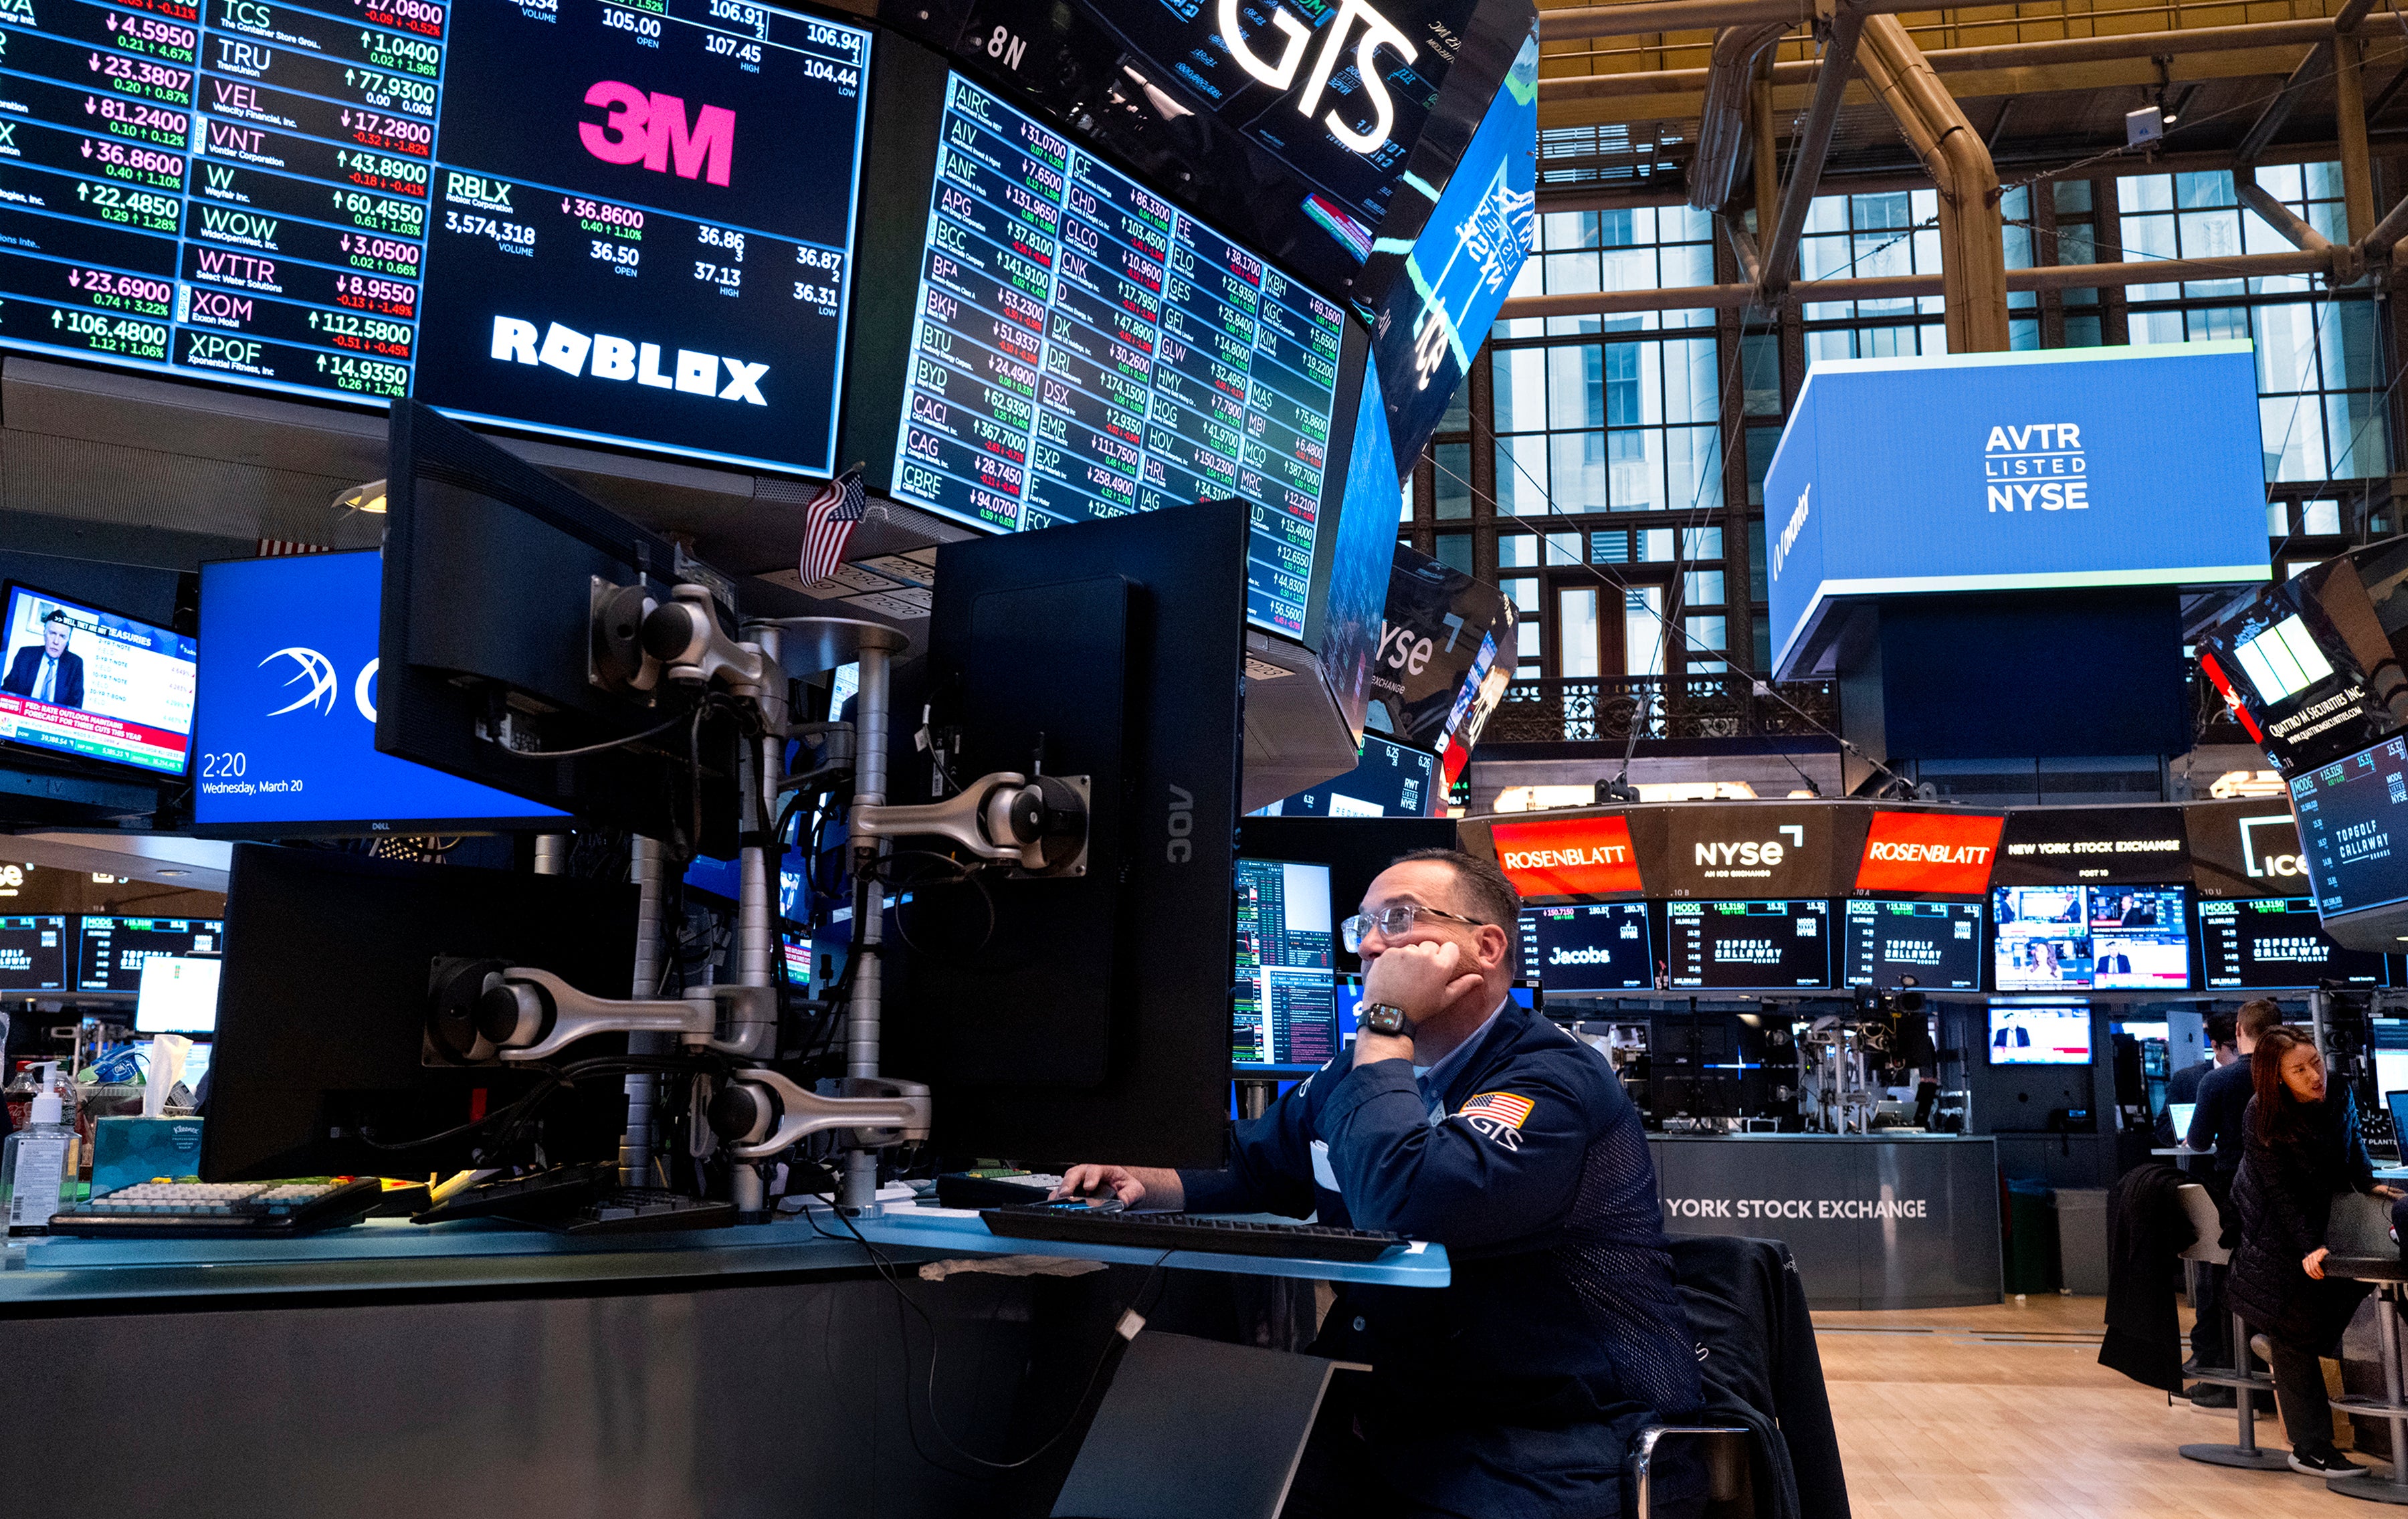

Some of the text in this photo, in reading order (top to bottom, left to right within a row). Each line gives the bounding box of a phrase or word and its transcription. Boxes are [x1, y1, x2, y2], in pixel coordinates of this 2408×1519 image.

[224, 0, 271, 28] TCS
[602, 8, 661, 38] 105.00
[709, 0, 765, 28] 106.91
[122, 17, 195, 49] 4.5950
[636, 35, 660, 49] OPEN
[807, 24, 861, 53] 106.94
[159, 45, 193, 62] 4.67%
[219, 38, 271, 70] TRU
[375, 34, 439, 64] 1.0400
[705, 34, 761, 64] 107.45
[987, 25, 1027, 71] 8N
[104, 56, 191, 91] 23.3807
[217, 60, 260, 78] TransUnion
[407, 61, 436, 77] 1.96%
[803, 58, 858, 88] 104.44
[155, 88, 189, 104] 0.87%
[215, 80, 264, 112] VEL
[359, 70, 435, 104] 77.9300
[402, 100, 433, 116] 0.00%
[957, 86, 990, 117] AIRC
[100, 99, 187, 134] 81.2400
[355, 112, 431, 144] 17.2800
[211, 122, 266, 153] VNT
[579, 80, 736, 187] 3M
[1027, 124, 1066, 160] 31.0700
[96, 142, 183, 177] 36.8600
[209, 144, 284, 167] Vontier Corporation
[350, 153, 427, 184] 43.8900
[947, 154, 977, 180] ANF
[207, 165, 234, 190] W
[447, 172, 511, 205] RBLX
[92, 186, 179, 219] 22.4850
[205, 186, 235, 201] Wayfair
[445, 193, 514, 214] Roblox Corporation
[1012, 188, 1057, 225] 131.9650
[1071, 187, 1096, 215] CHD
[346, 193, 423, 224] 60.4550
[574, 199, 643, 229] 36.8600
[142, 215, 176, 231] 1.28%
[203, 207, 277, 241] WOW
[445, 211, 536, 245] 3,574,318
[614, 225, 641, 241] 1.10%
[937, 221, 967, 249] BCC
[354, 235, 419, 264] 3.0500
[498, 242, 534, 258] VOLUME
[698, 225, 744, 250] 36.86
[1013, 223, 1053, 257] 37.8100
[199, 248, 275, 284] WTTR
[590, 240, 639, 266] 36.50
[796, 246, 841, 271] 36.87
[1174, 247, 1194, 272] FLO
[222, 274, 246, 288] Water
[614, 266, 637, 278] OPEN
[694, 261, 741, 287] 37.13
[84, 271, 171, 302] 23.6900
[350, 276, 415, 304] 8.9550
[719, 286, 739, 298] HIGH
[793, 282, 838, 307] 36.31
[134, 300, 168, 316] 3.22%
[193, 290, 253, 322] XOM
[819, 306, 836, 318] LOW
[928, 290, 957, 320] BKH
[67, 312, 167, 346] 106.4800
[191, 312, 239, 328] Exxon Mobil
[322, 313, 411, 344] 112.5800
[189, 333, 262, 364] XPOF
[922, 324, 952, 351] BTU
[330, 357, 407, 385] 14.9350
[490, 314, 771, 407] ROBLOX
[1044, 380, 1070, 405] DSX
[1253, 387, 1272, 408] MAS
[913, 395, 946, 423] CACI
[1985, 422, 2081, 452] AVTR
[904, 466, 942, 495] CBRE
[1288, 462, 1320, 488] 387.7000
[1985, 458, 2086, 477] LISTED
[977, 491, 1017, 520] 94.0700
[1987, 482, 2090, 513] NYSE
[1274, 602, 1302, 623] 56.5600
[24, 709, 142, 742] FORECAST FOR THREE CUTS THIS YEAR
[41, 705, 58, 715] RATE
[59, 709, 90, 722] OUTLOOK
[90, 716, 123, 730] MAINTAINS
[2298, 710, 2311, 724] M
[203, 752, 246, 777] 2:20
[1386, 745, 1399, 759] 6.25
[202, 780, 303, 796] Wednesday, March 20
[1405, 778, 1419, 791] RWT
[2386, 771, 2402, 784] MODG
[1401, 798, 1417, 811] NYSE
[2391, 791, 2407, 804] NYSE
[372, 822, 390, 830] DELL
[1167, 784, 1193, 864] AOC
[2336, 819, 2377, 843] TOPGOLF
[1504, 845, 1626, 870] ROSENBLATT
[1870, 841, 1990, 865] ROSENBLATT
[2008, 840, 2180, 855] NEW YORK STOCK EXCHANGE
[2339, 833, 2389, 858] CALLAWAY
[1674, 903, 1701, 912] MODG
[2205, 902, 2235, 911] MODG
[1549, 946, 1611, 965] Jacobs
[1667, 1199, 1927, 1218] YORK STOCK EXCHANGE
